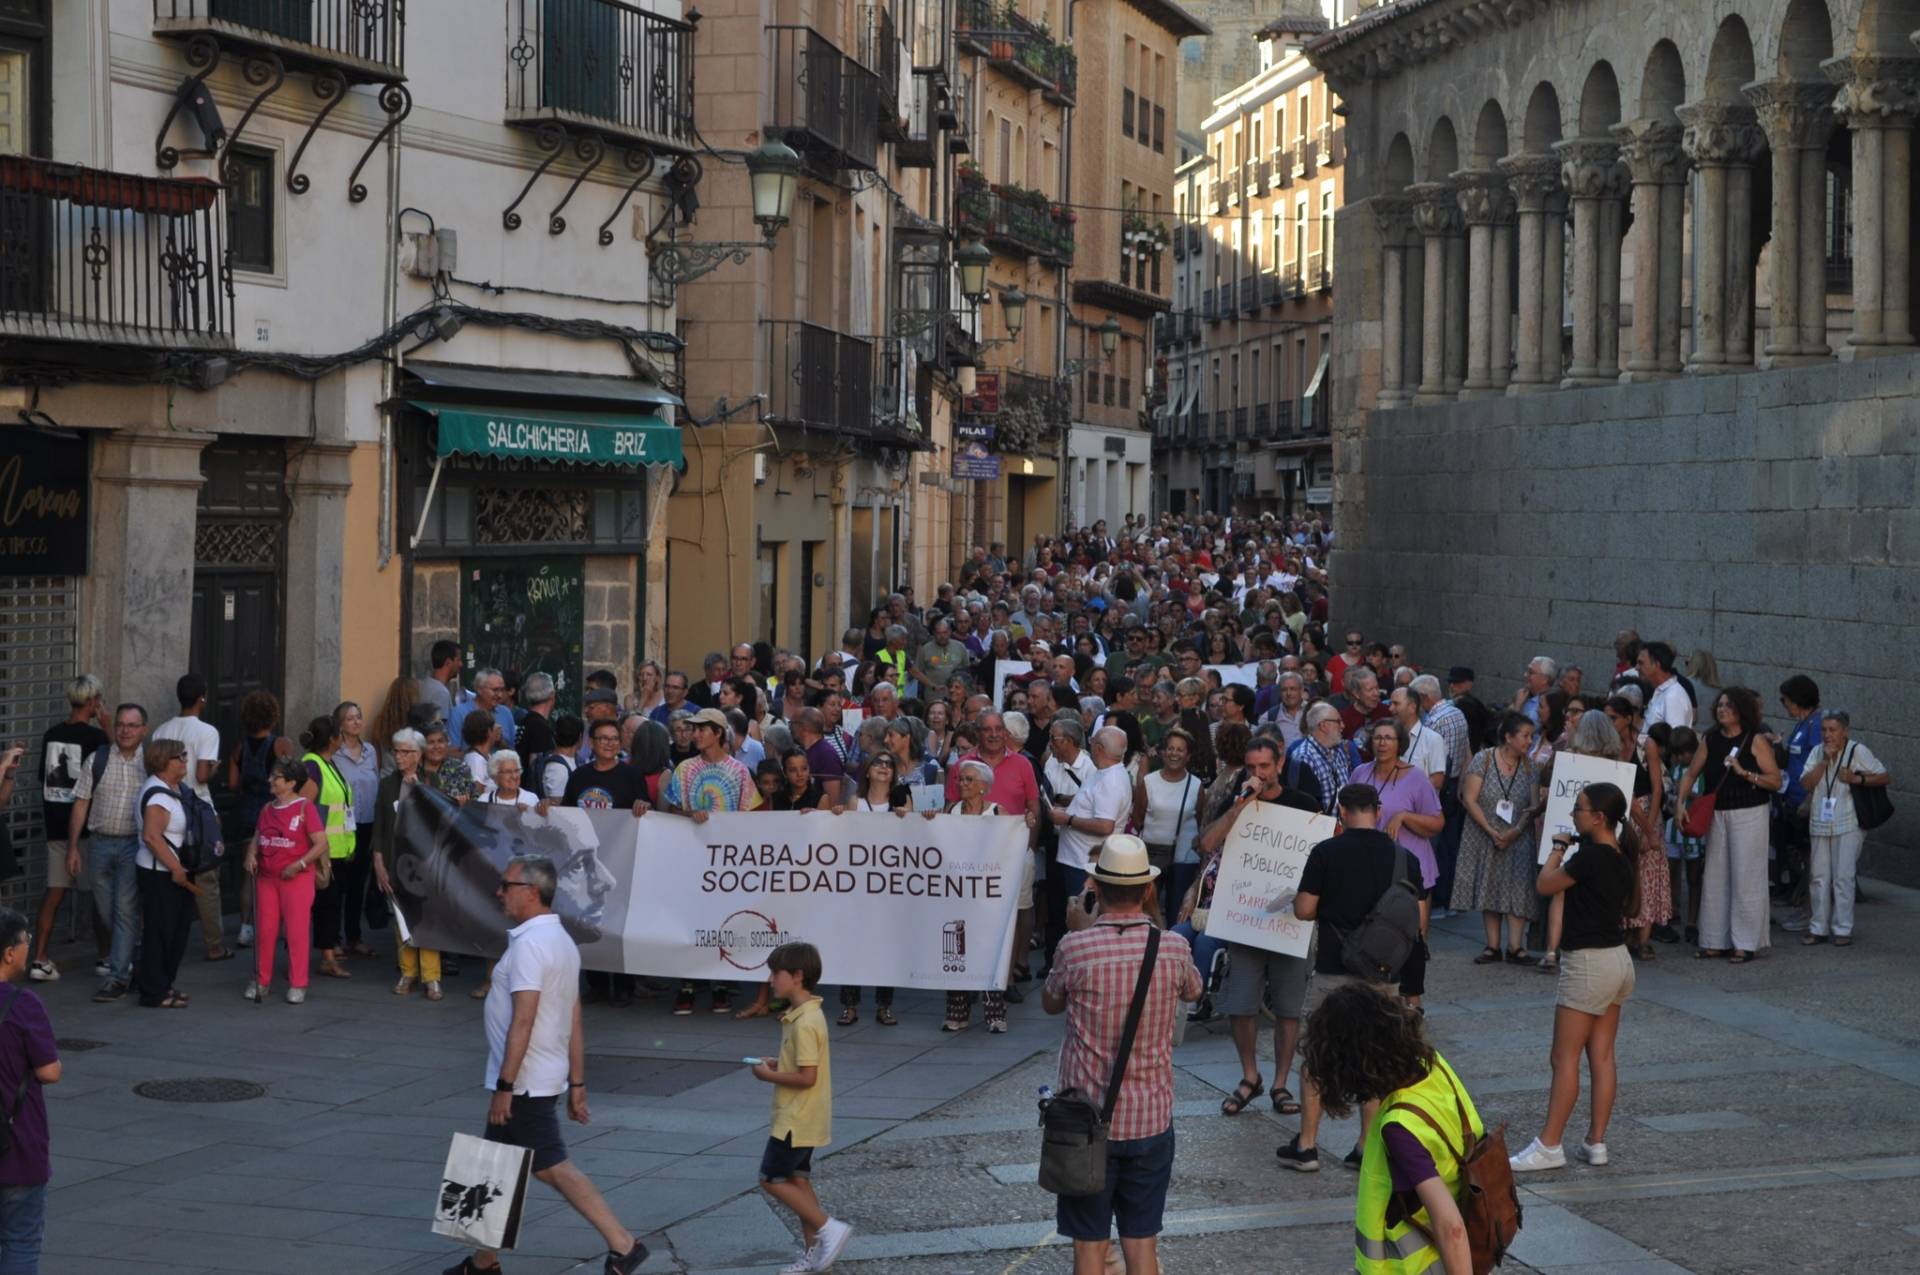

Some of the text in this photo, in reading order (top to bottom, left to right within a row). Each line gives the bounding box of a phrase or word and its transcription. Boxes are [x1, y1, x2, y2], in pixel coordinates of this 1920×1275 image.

[487, 421, 591, 453] SALCHICHERIA
[614, 432, 647, 456] BRIZ
[959, 427, 987, 436] PILAS
[1239, 822, 1318, 857] SERVICIOS
[706, 844, 944, 869] TRABAJO DIGNO
[701, 870, 1003, 898] SOCIEDAD DECENTE
[694, 929, 735, 948] TRABAJO
[1226, 910, 1300, 941] POPULARES
[943, 954, 966, 963] HOAC
